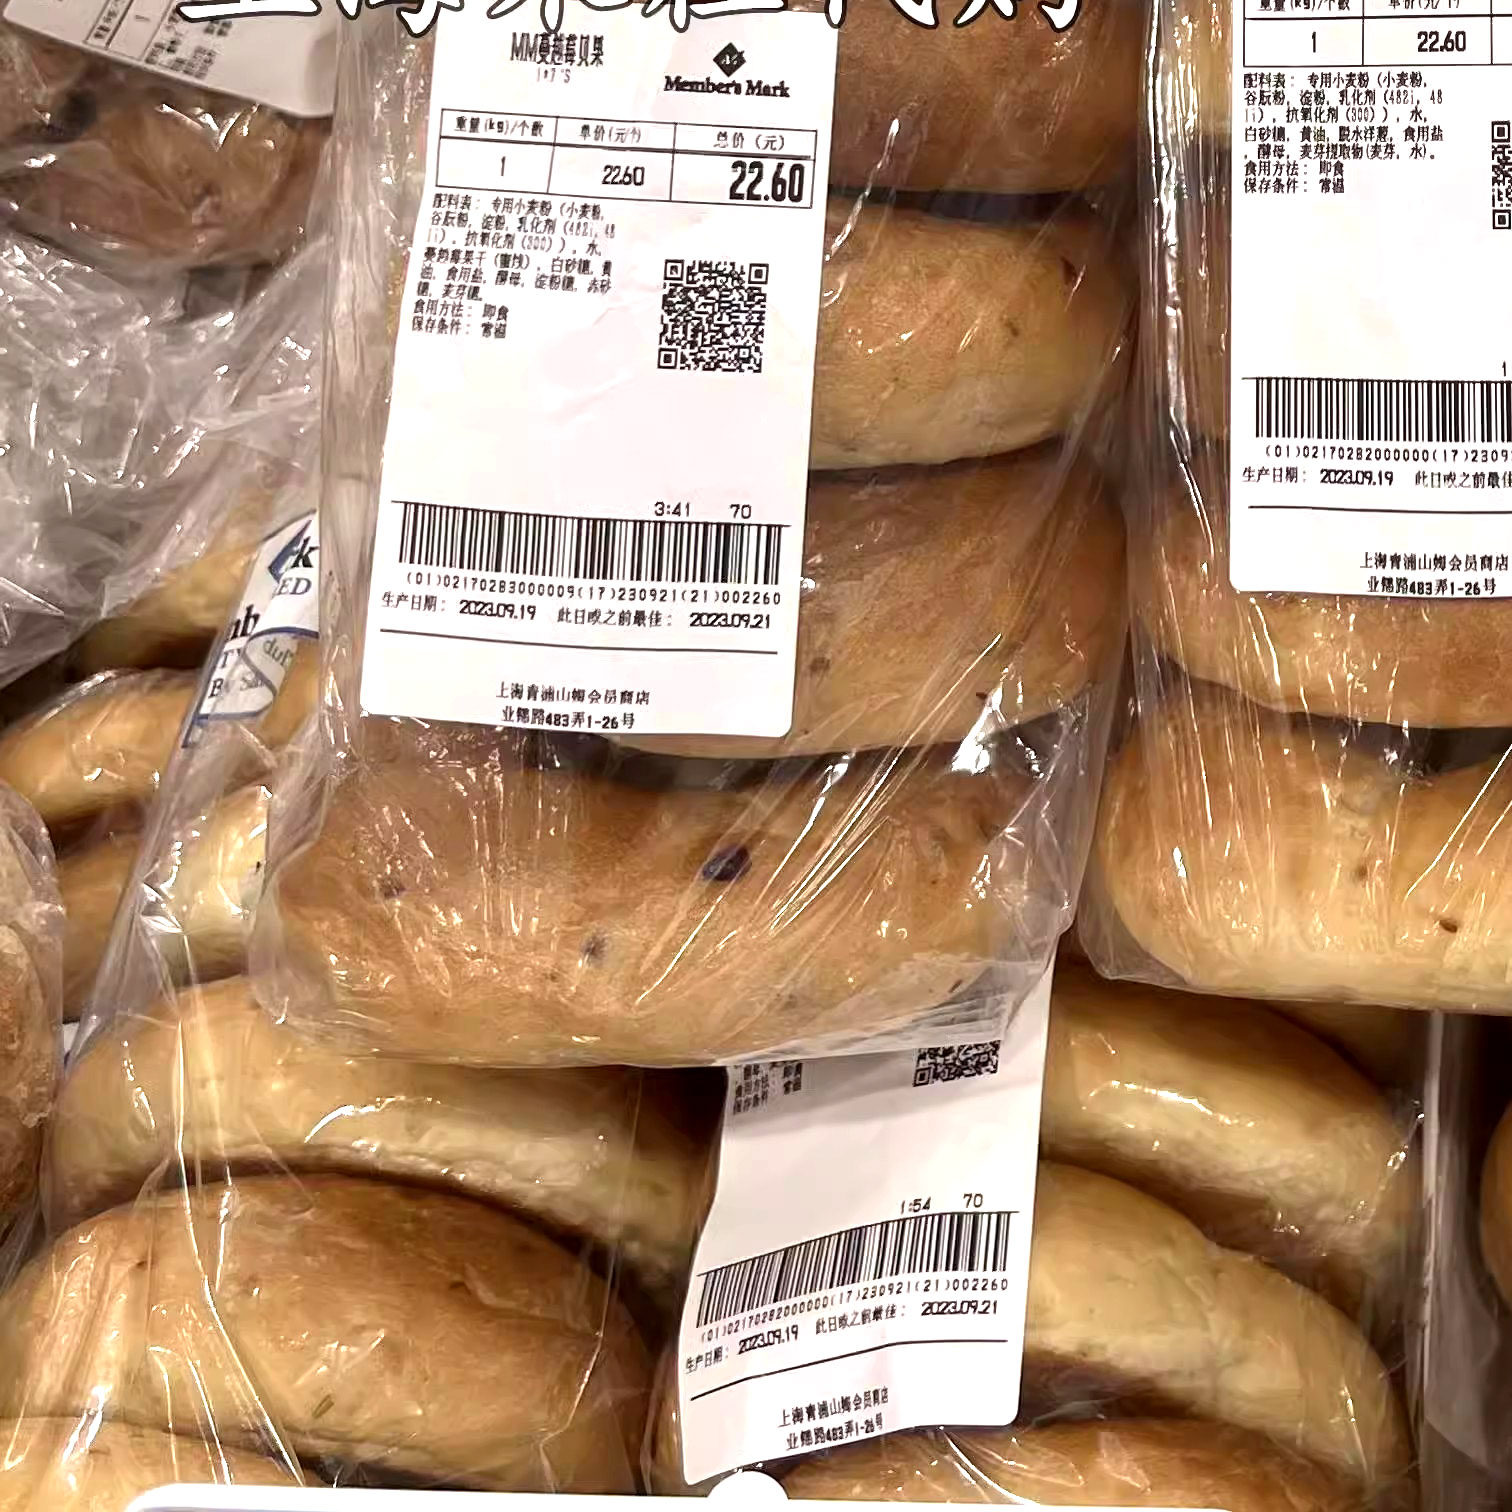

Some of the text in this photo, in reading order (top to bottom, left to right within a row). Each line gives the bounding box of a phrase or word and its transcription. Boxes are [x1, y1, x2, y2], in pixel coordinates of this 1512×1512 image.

[1311, 31, 1317, 53] 1
[1417, 30, 1467, 53] 22.60
[500, 156, 506, 177] 1
[601, 165, 645, 186] 22.60
[729, 161, 804, 202] 22.60
[1320, 469, 1394, 486] 2023.09.19
[655, 501, 752, 519] 3:41 70
[459, 600, 537, 621] 2023.09.19
[689, 612, 770, 629] 2023.09.21
[901, 1193, 984, 1214] 1:54 70
[738, 1328, 799, 1355] 2023.09.19
[921, 1300, 998, 1317] 2023.09.21
